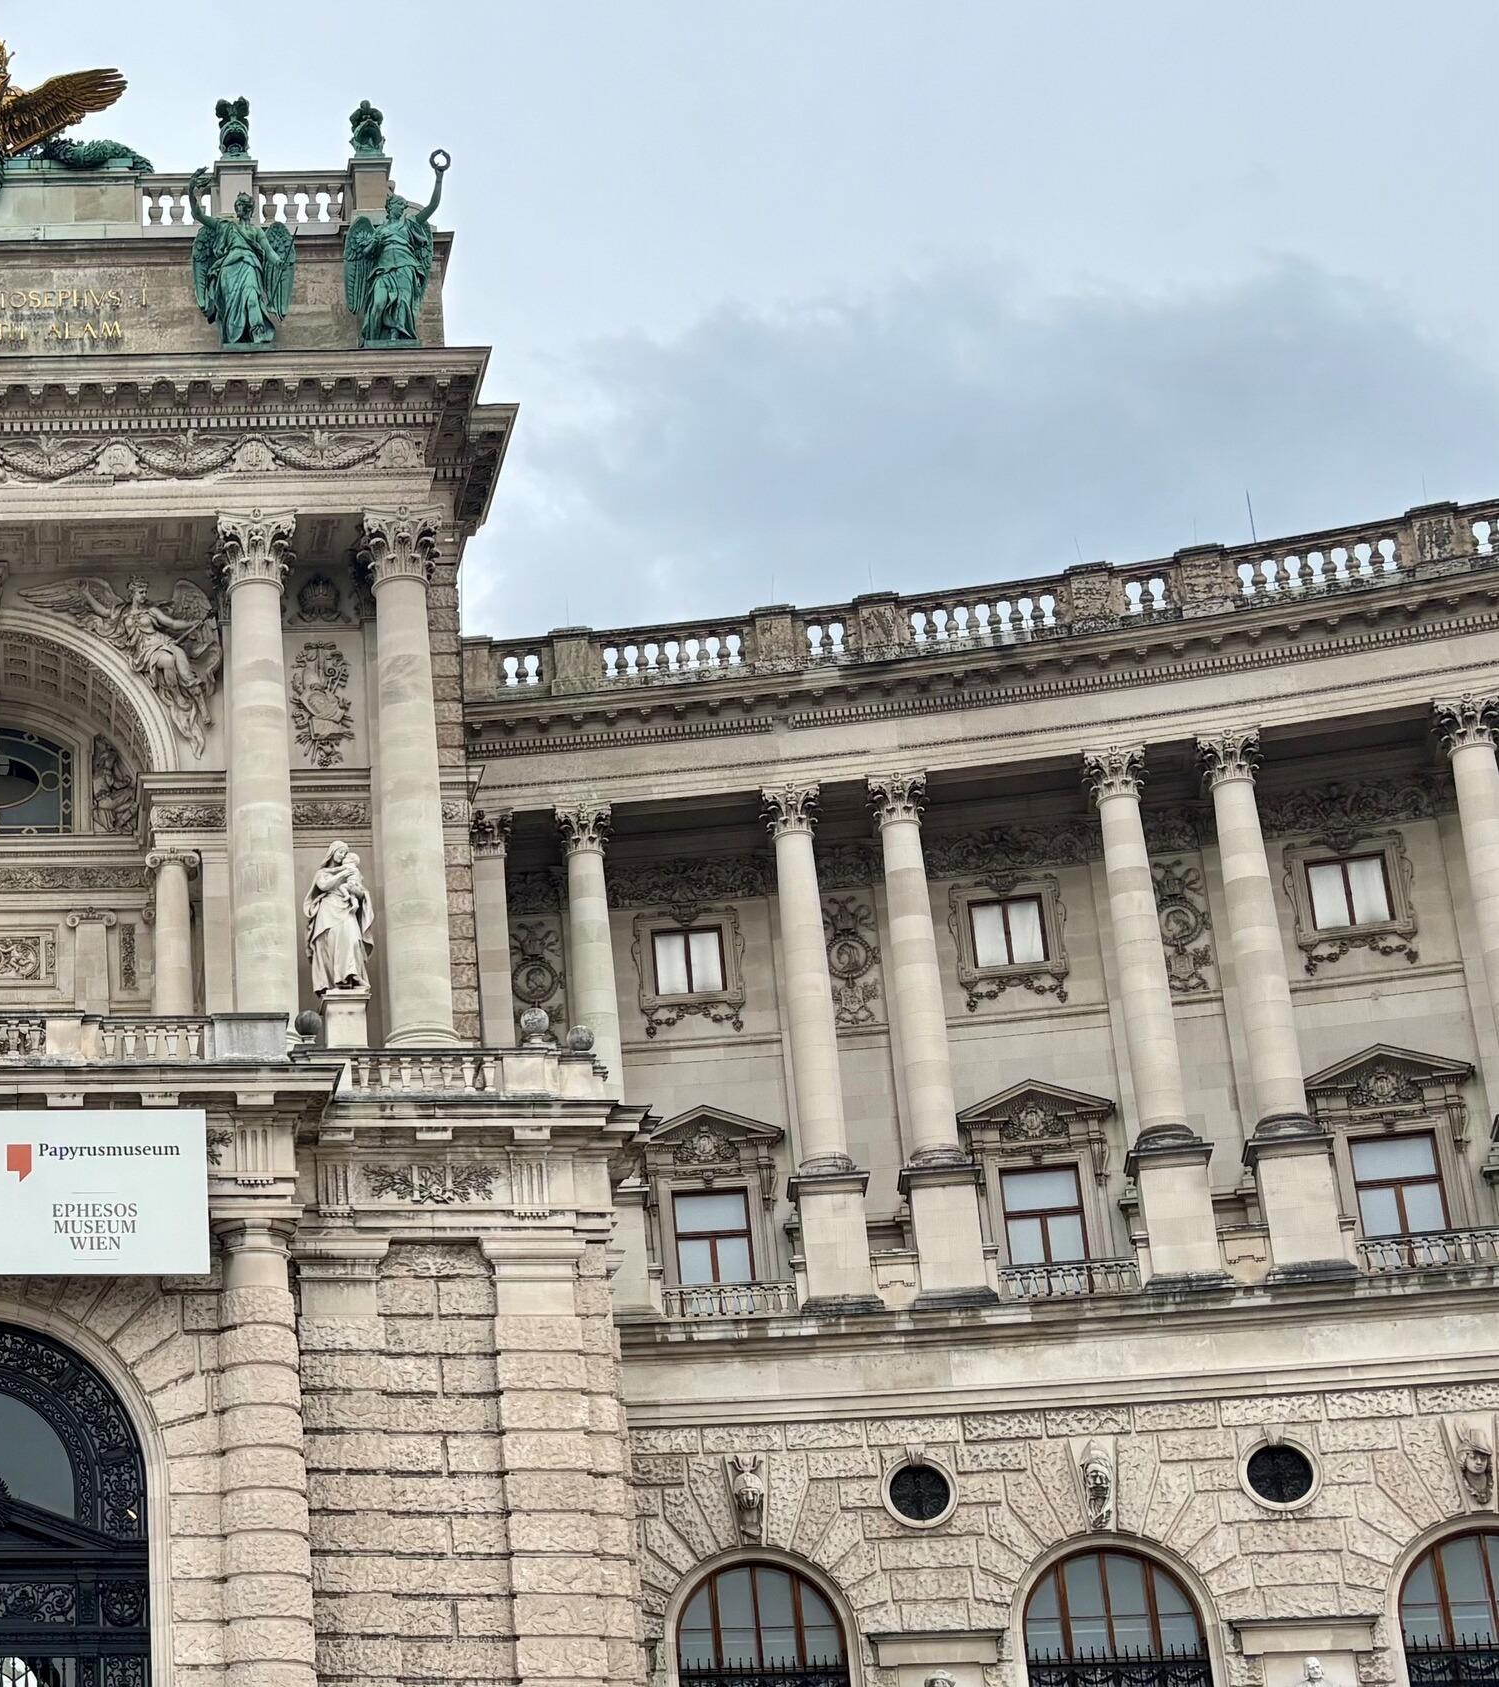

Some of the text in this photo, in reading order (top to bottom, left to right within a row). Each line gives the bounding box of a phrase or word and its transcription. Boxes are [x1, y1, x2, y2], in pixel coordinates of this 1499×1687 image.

[0, 288, 122, 309] IOSEPHVS
[47, 320, 123, 340] ALAM
[39, 1142, 180, 1160] Papyrusmuseum
[53, 1203, 137, 1217] EPHESOS
[54, 1220, 135, 1233] MUSEUM
[70, 1237, 120, 1250] WIEN
